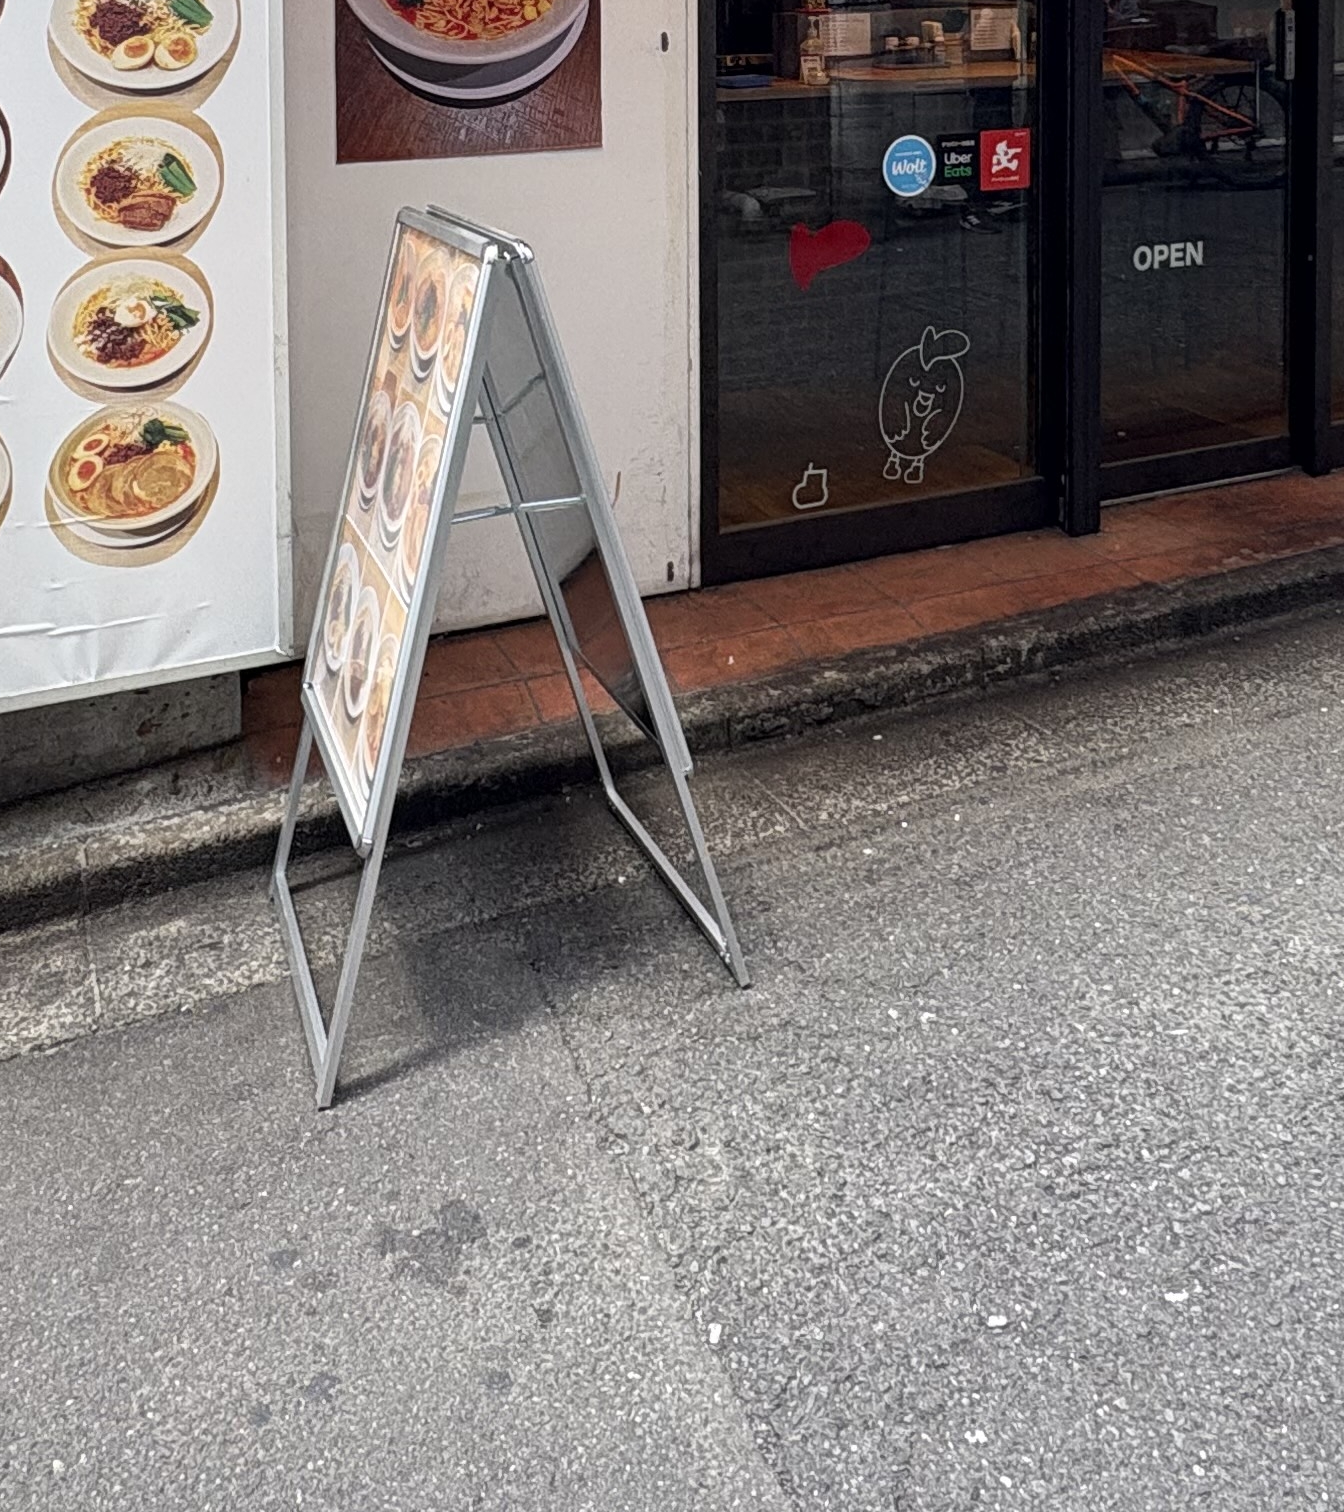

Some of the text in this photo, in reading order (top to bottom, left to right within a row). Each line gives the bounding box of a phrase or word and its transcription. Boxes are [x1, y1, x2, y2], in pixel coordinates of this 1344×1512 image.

[943, 152, 973, 165] Uber
[891, 158, 927, 176] Wolt
[943, 165, 973, 178] Eats
[1133, 240, 1204, 272] OPEN
